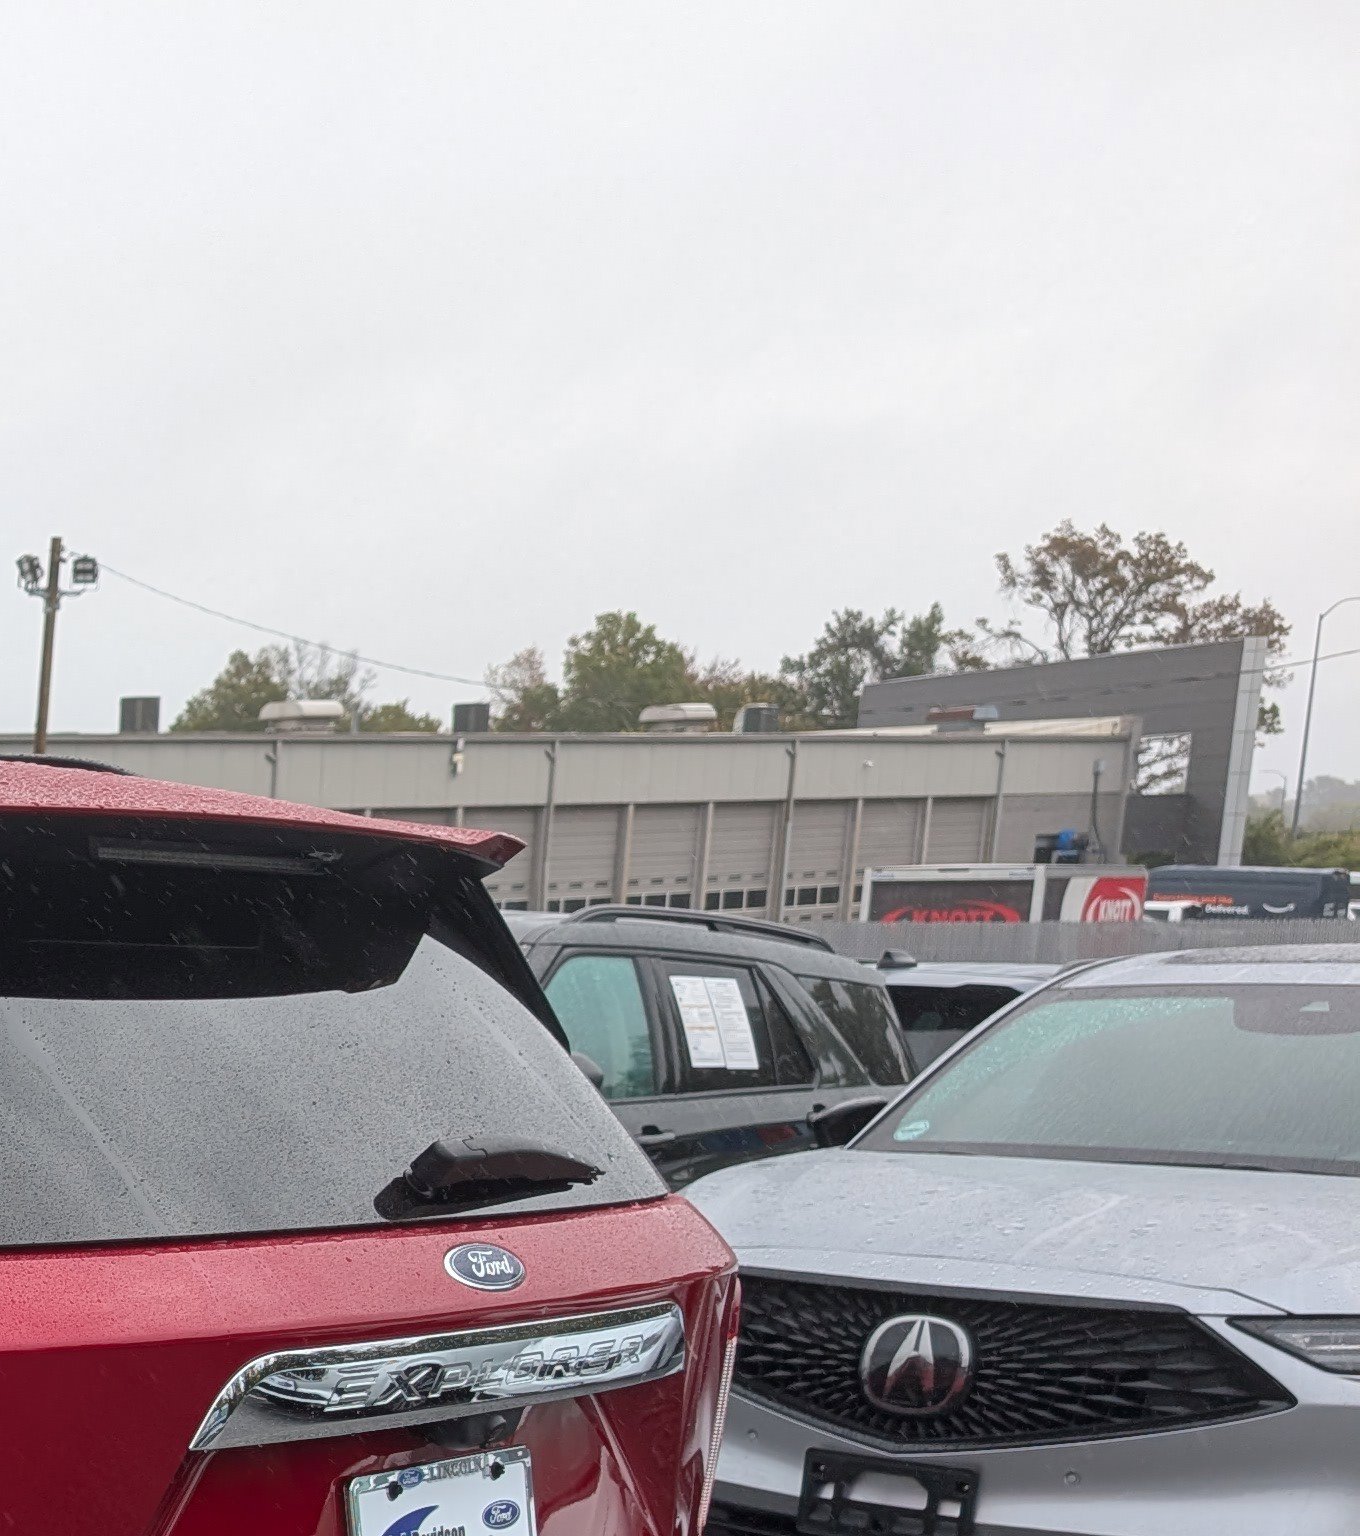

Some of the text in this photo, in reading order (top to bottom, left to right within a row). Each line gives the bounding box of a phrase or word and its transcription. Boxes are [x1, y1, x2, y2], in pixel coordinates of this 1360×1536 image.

[467, 1250, 514, 1278] Ford
[323, 1334, 646, 1414] EXPLORER
[489, 1504, 513, 1524] Ford
